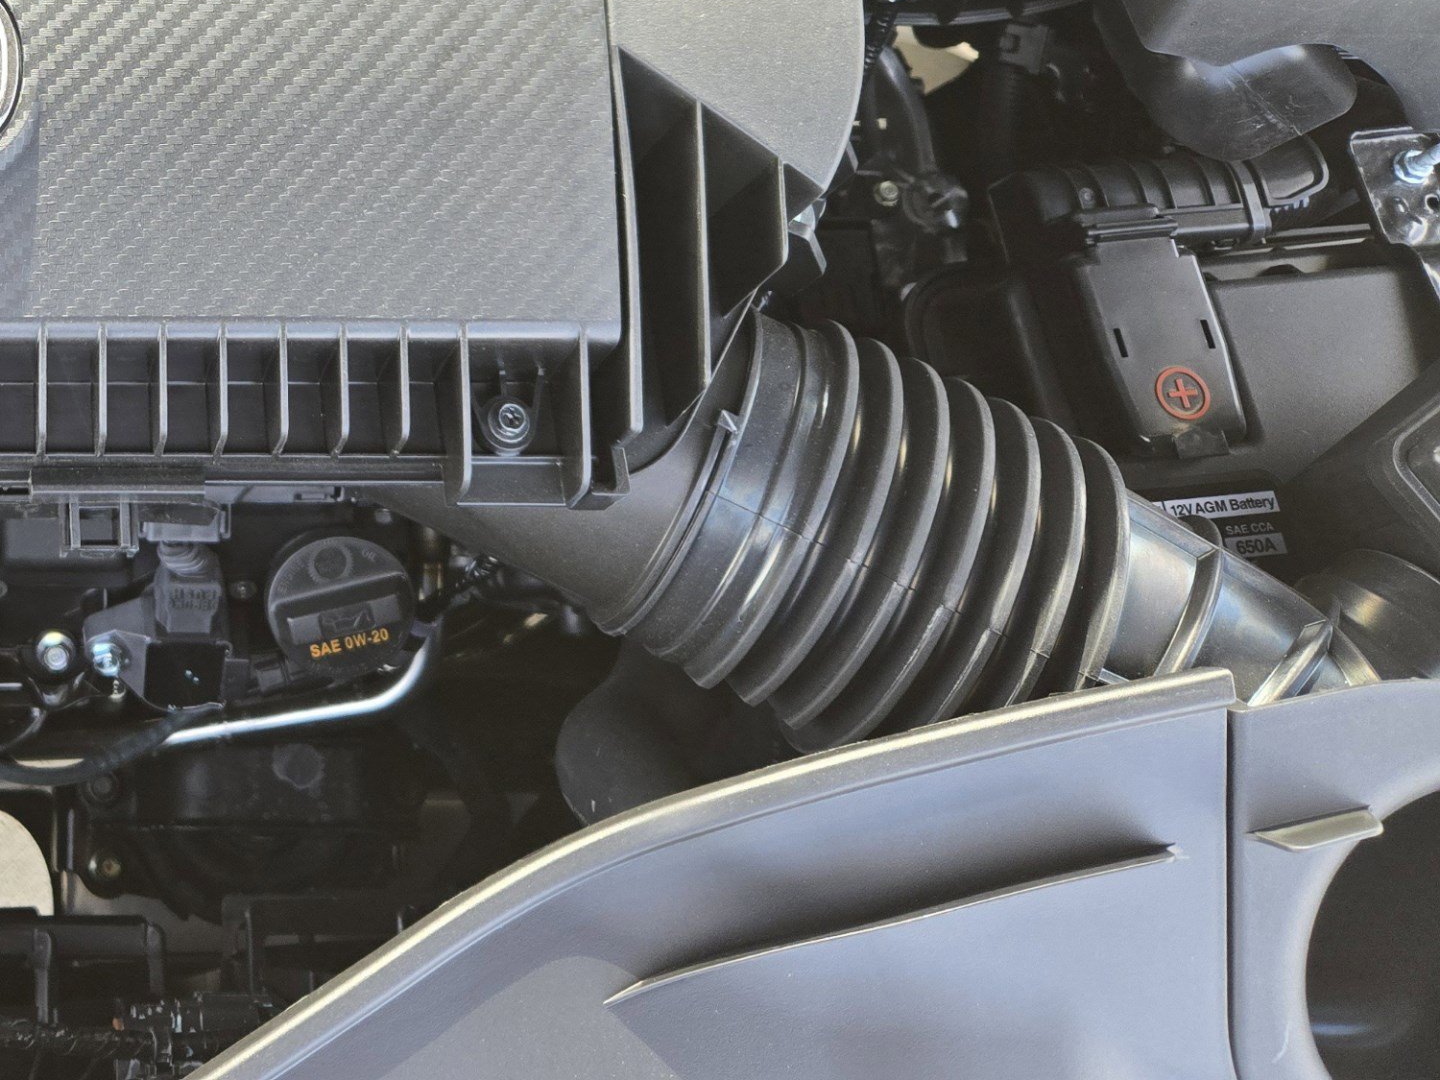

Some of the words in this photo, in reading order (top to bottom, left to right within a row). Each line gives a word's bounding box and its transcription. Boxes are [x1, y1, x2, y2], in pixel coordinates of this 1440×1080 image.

[1170, 503, 1192, 517] 12V
[1196, 499, 1228, 514] AGM
[1230, 496, 1275, 511] Battery
[1225, 523, 1249, 535] SAE
[1251, 521, 1274, 533] CCA
[1236, 537, 1277, 555] 650A
[309, 639, 342, 658] SAE
[345, 627, 389, 650] 0W-20
